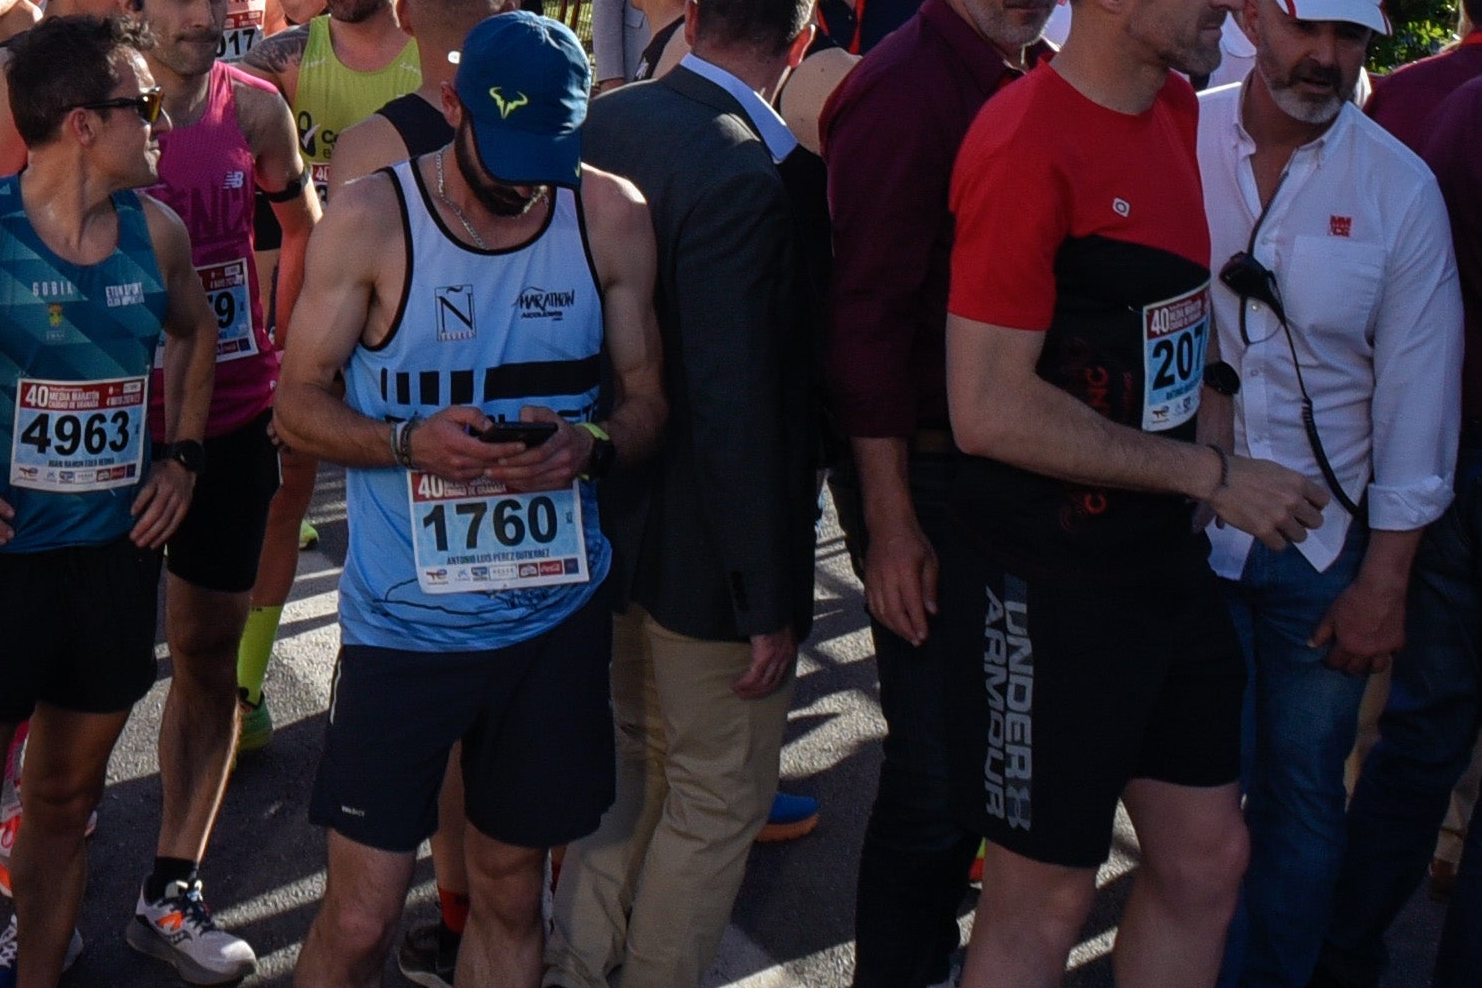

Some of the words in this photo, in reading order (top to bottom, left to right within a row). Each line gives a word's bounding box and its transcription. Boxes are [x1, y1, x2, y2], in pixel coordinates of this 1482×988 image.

[437, 285, 475, 332] Ñ
[1152, 324, 1205, 391] 207
[25, 385, 49, 407] 40
[21, 410, 130, 456] 4963
[418, 474, 444, 499] 40
[423, 496, 558, 552] 1760
[446, 554, 477, 565] ANTONIO
[478, 553, 493, 563] LUIS
[493, 551, 515, 562] PEREZ
[515, 549, 551, 561] GUTIERREZ
[983, 585, 1008, 820] ARMOUR
[1004, 600, 1034, 780] UNDER
